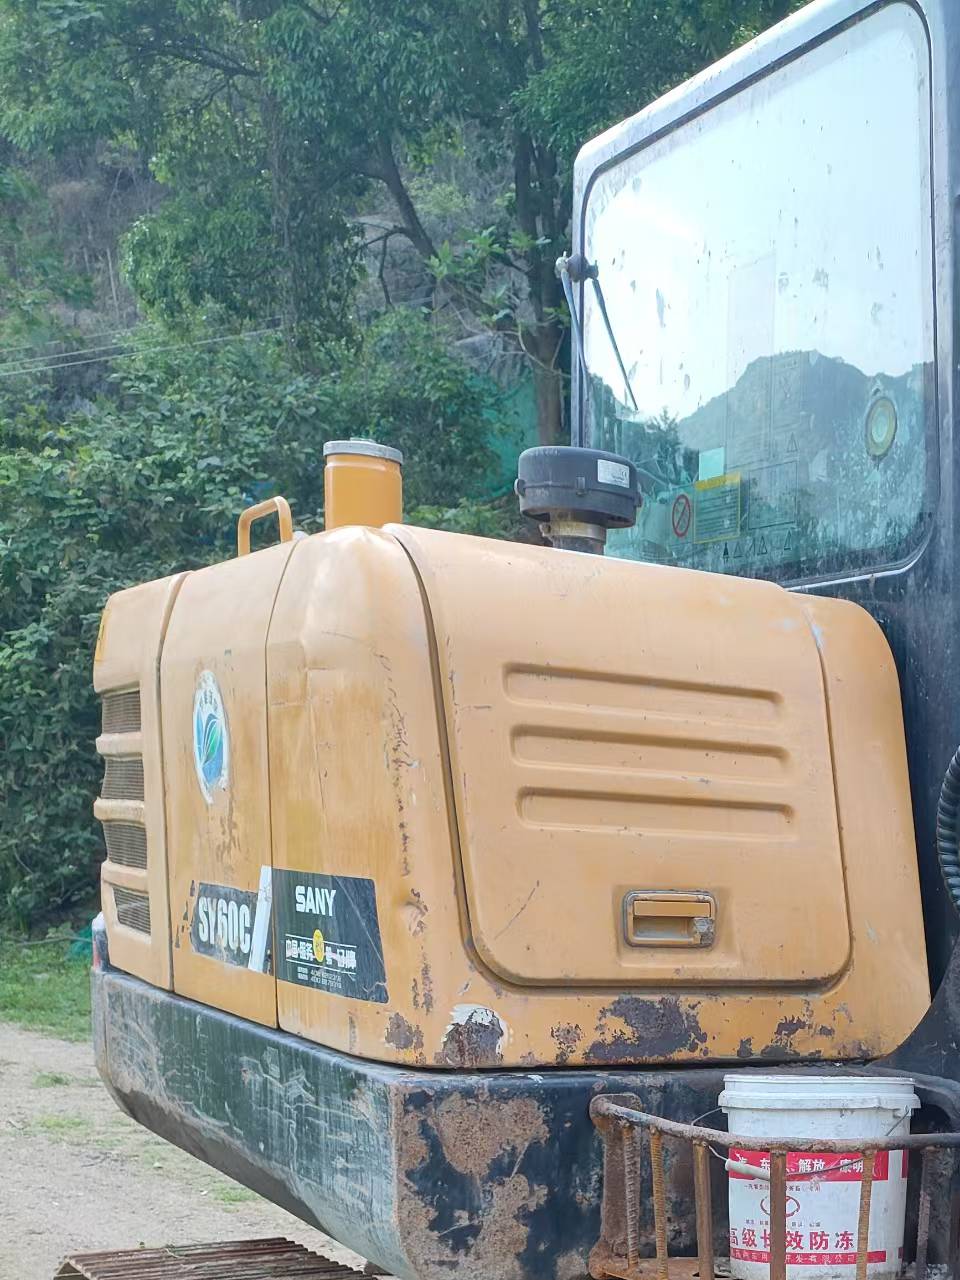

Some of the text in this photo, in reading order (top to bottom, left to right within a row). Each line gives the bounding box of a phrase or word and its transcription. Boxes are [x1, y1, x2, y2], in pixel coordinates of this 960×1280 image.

[295, 885, 336, 917] SANY
[198, 896, 251, 954] SY60C
[799, 1158, 825, 1173] 解放
